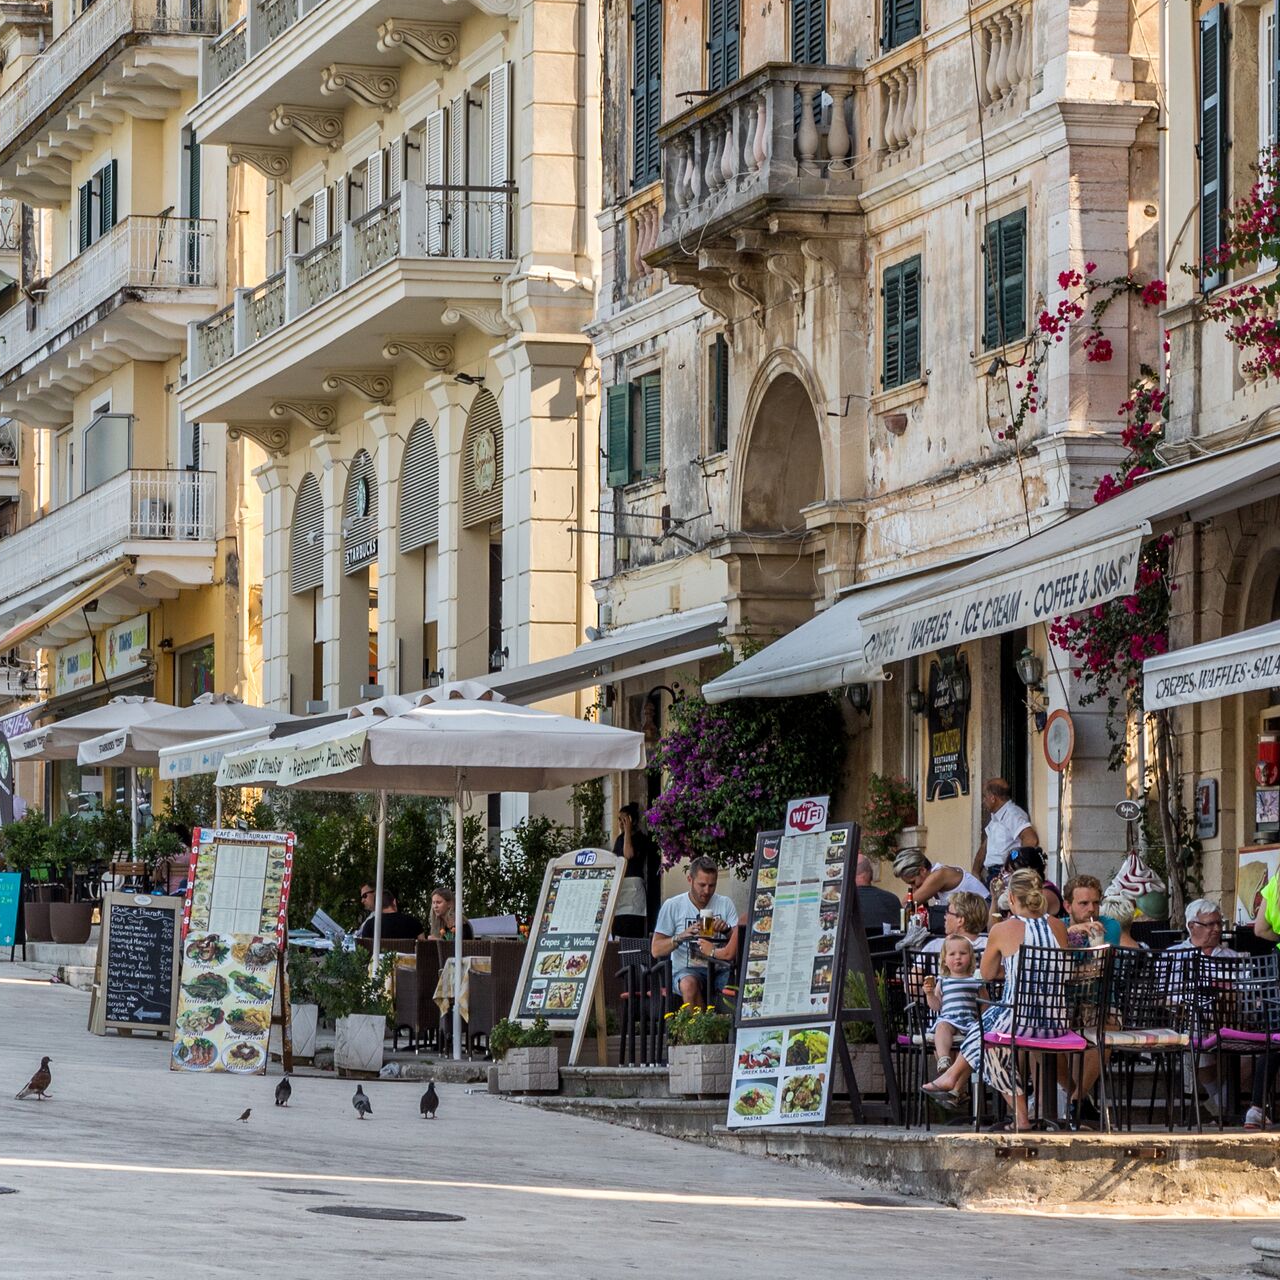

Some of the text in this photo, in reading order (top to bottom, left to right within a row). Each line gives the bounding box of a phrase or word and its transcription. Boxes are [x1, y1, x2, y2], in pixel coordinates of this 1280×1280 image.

[345, 538, 377, 566] STARBUCKS
[907, 610, 953, 651] WAFFLES
[960, 601, 983, 636] ICE
[982, 590, 1023, 630] CREAM
[1033, 572, 1080, 618] COFFEE
[1156, 671, 1195, 699] CREPES
[1198, 662, 1248, 690] WAFFLES
[183, 846, 199, 925] GYROS
[277, 838, 294, 946] SOUVLAKI
[540, 937, 560, 949] Crepes
[573, 936, 596, 948] Waffles
